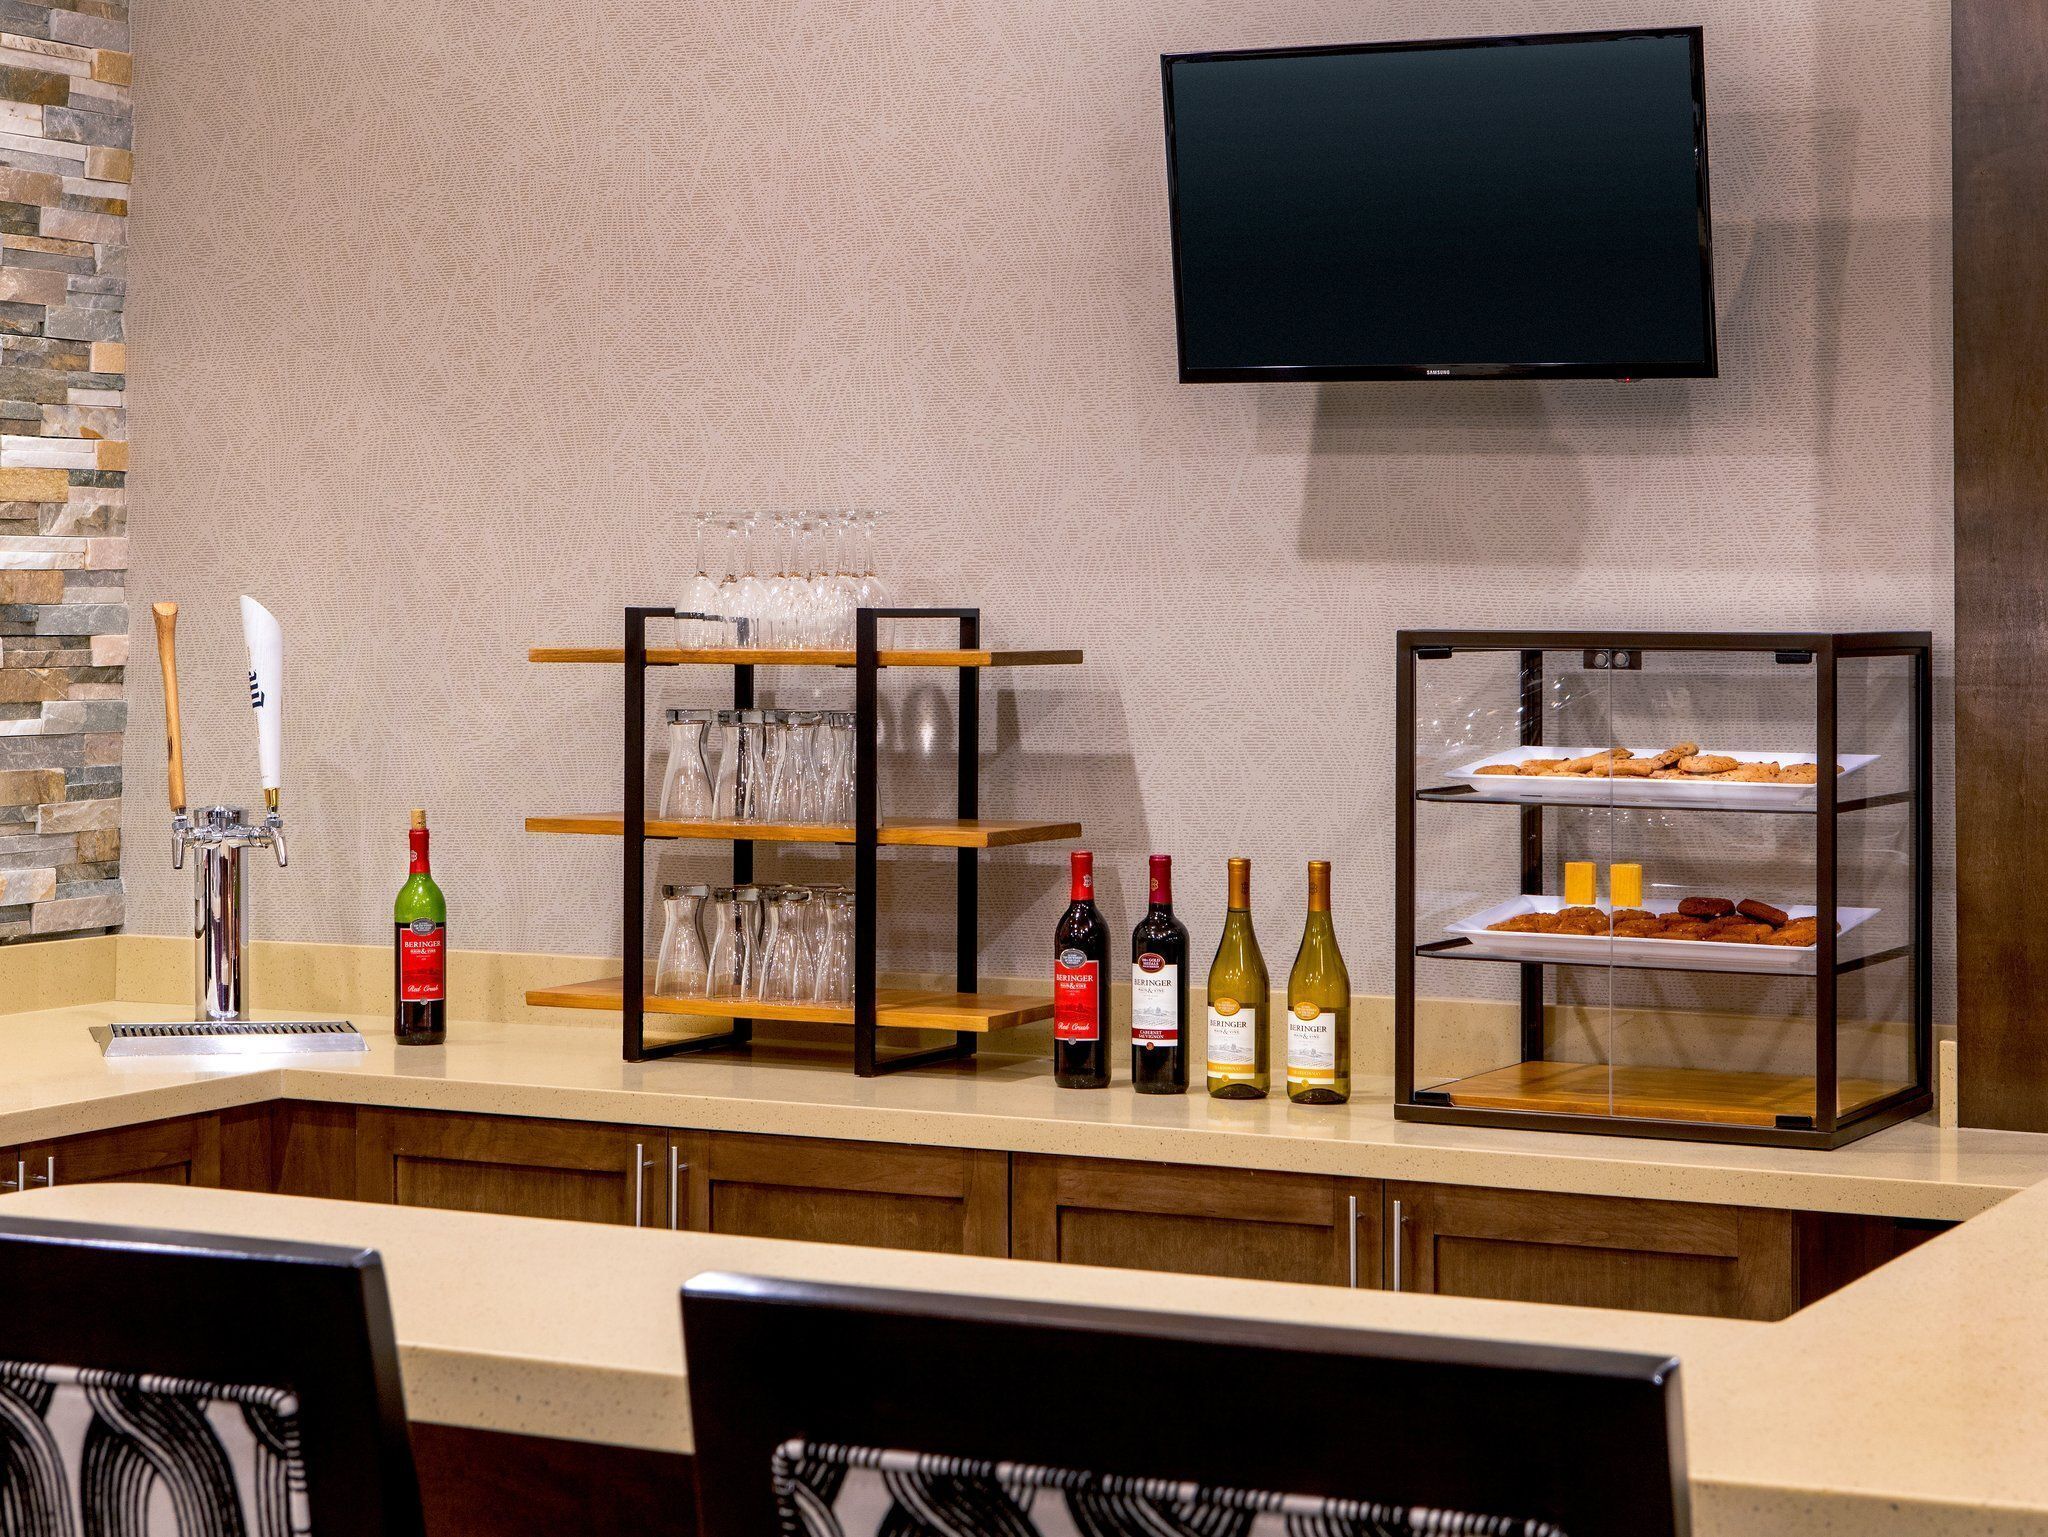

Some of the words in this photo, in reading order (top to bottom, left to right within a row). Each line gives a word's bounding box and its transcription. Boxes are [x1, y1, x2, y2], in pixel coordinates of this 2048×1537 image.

[1056, 973, 1093, 982] BERINGER
[1134, 978, 1172, 986] BERINGER
[407, 985, 421, 993] Red
[1058, 1021, 1070, 1030] Red
[1072, 1023, 1089, 1031] Crush
[1210, 1019, 1247, 1028] BERINGER
[1290, 1024, 1327, 1033] BERINGER
